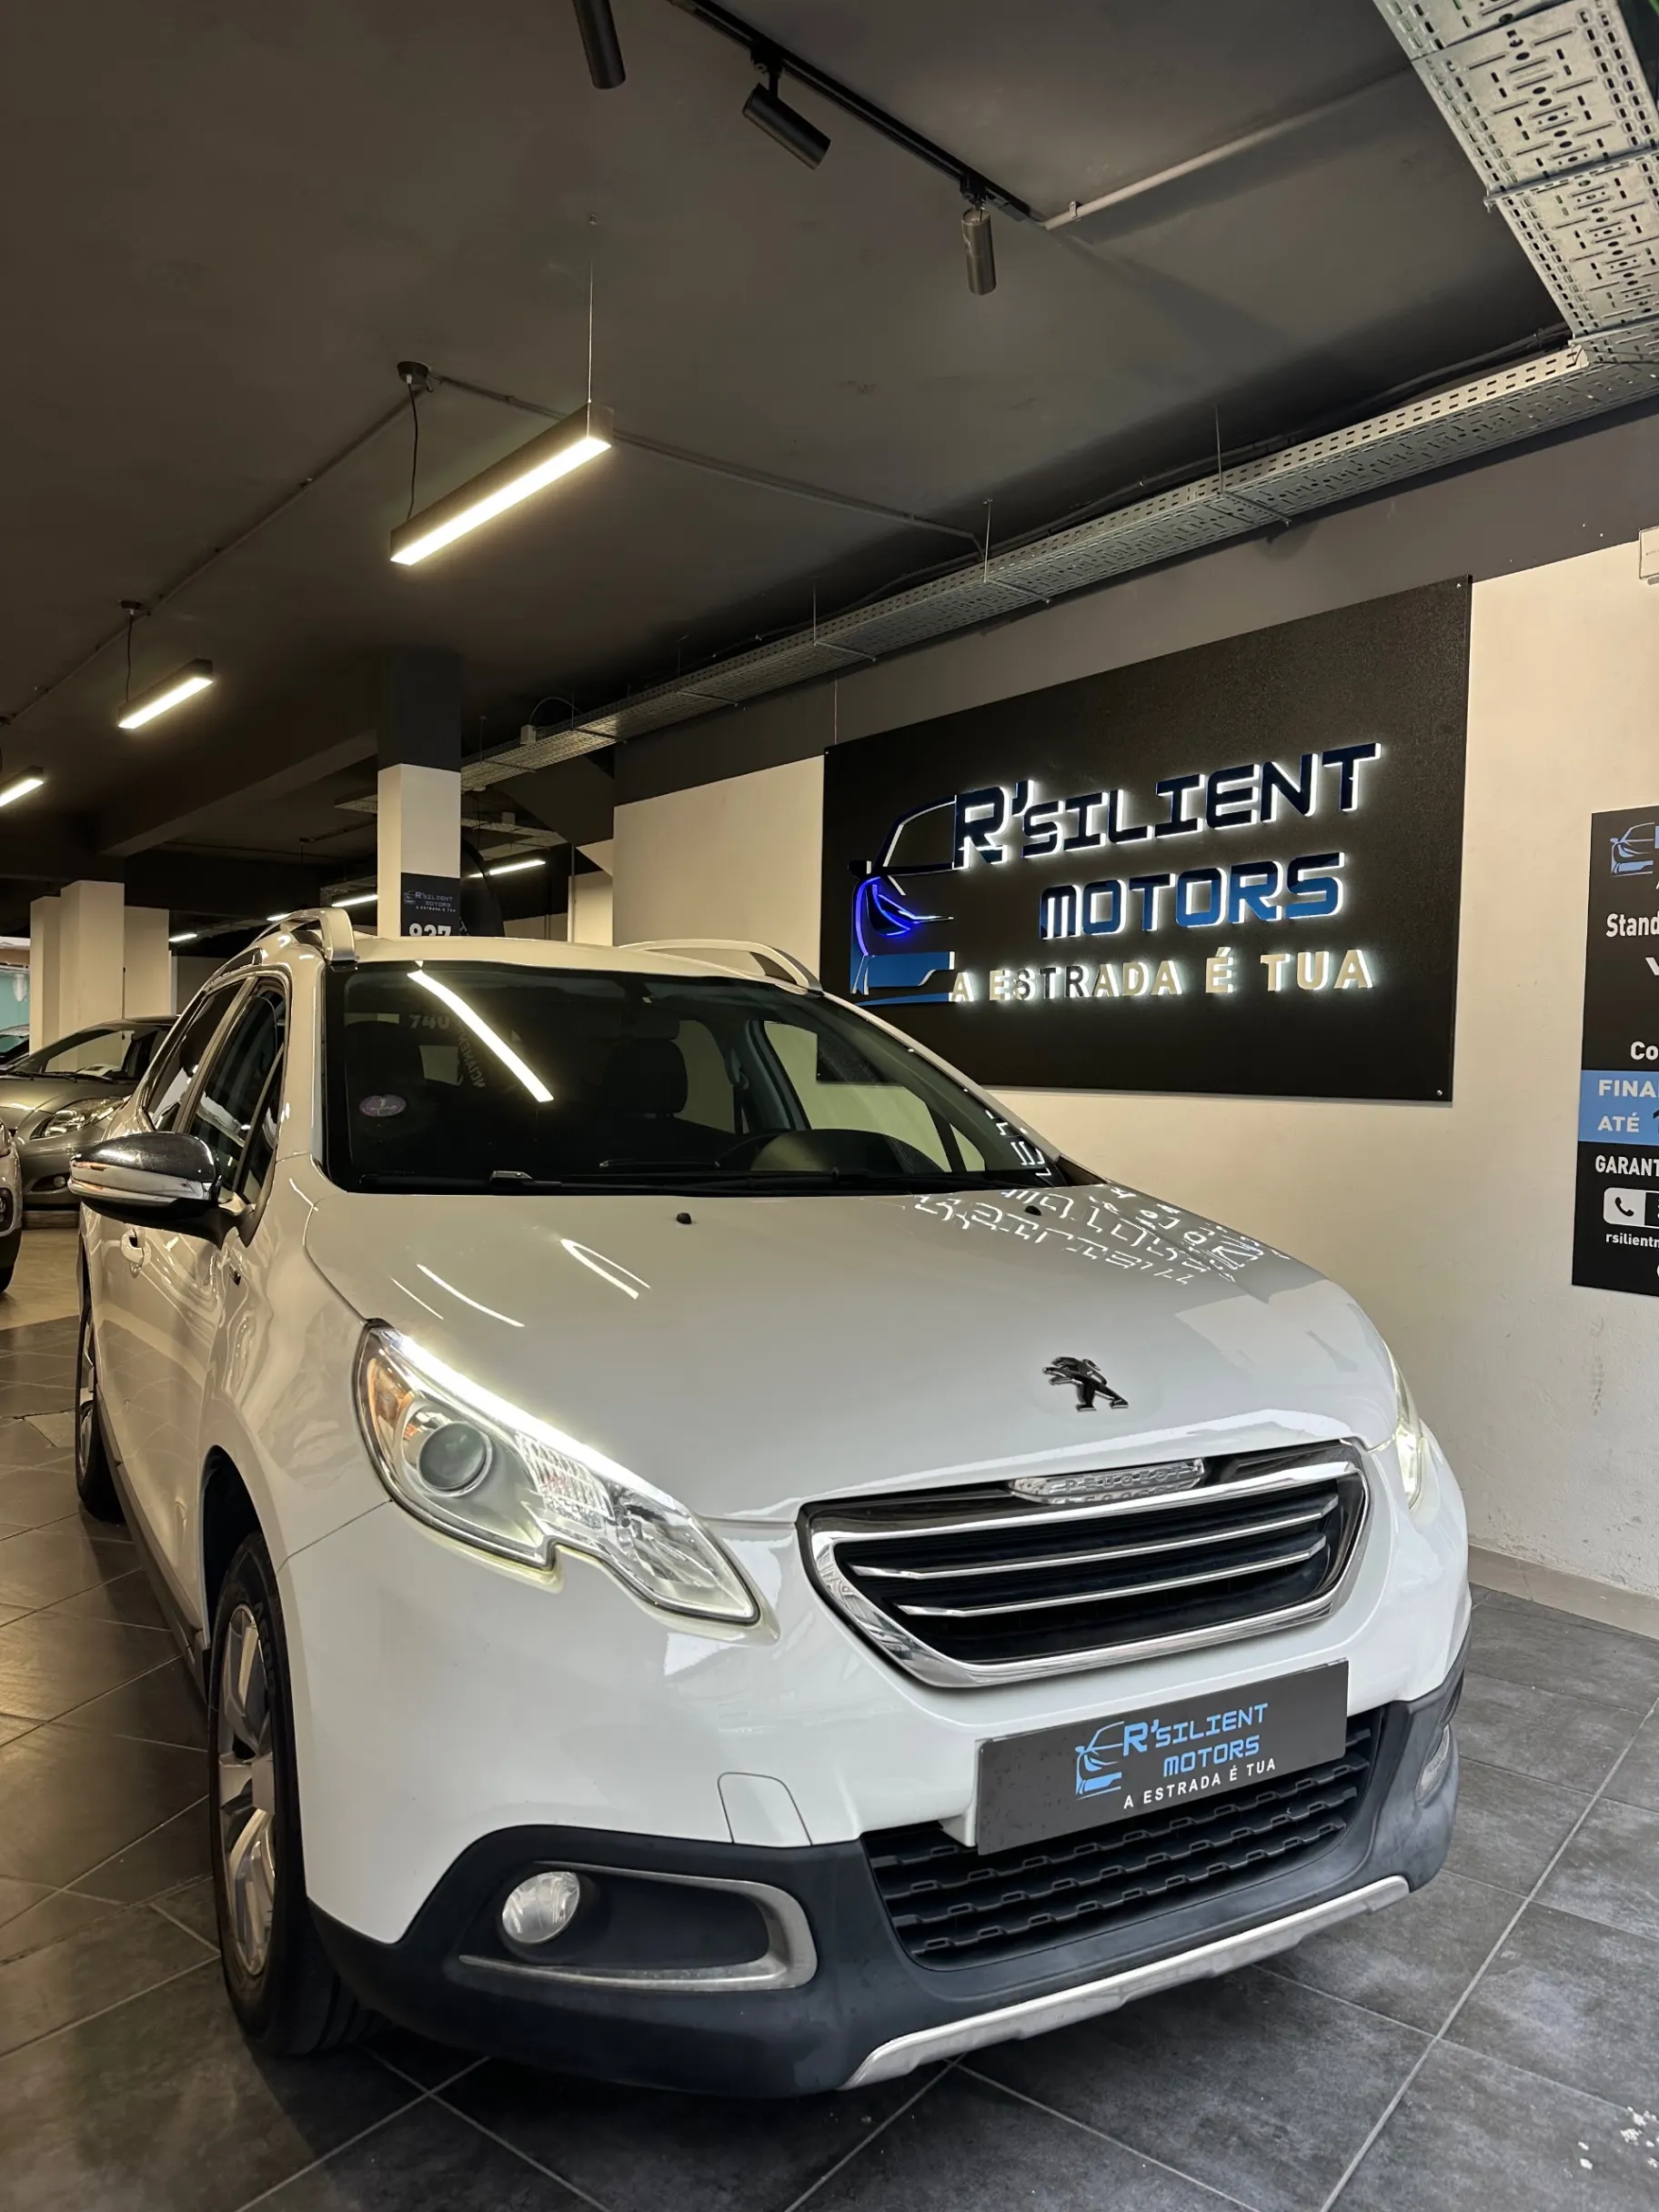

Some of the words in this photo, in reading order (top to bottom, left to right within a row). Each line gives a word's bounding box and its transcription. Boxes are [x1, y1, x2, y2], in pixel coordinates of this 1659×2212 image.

[952, 742, 1382, 870] R'SILIENT
[1040, 851, 1346, 940] MOTORS
[951, 971, 975, 1002] A
[989, 960, 1183, 1001] ESTRADA
[1204, 947, 1235, 994] É
[1261, 949, 1374, 992] TUA
[1599, 1080, 1659, 1098] FINA
[1597, 1111, 1640, 1133] ATÉ
[1065, 1466, 1184, 1493] PEUGEOT
[1123, 1703, 1269, 1757] R'SILIENT
[1163, 1734, 1260, 1777] MOTORS
[1123, 1795, 1134, 1809] A
[1143, 1773, 1222, 1805] ESTRADA
[1229, 1765, 1238, 1782] É
[1247, 1758, 1276, 1776] TUA
